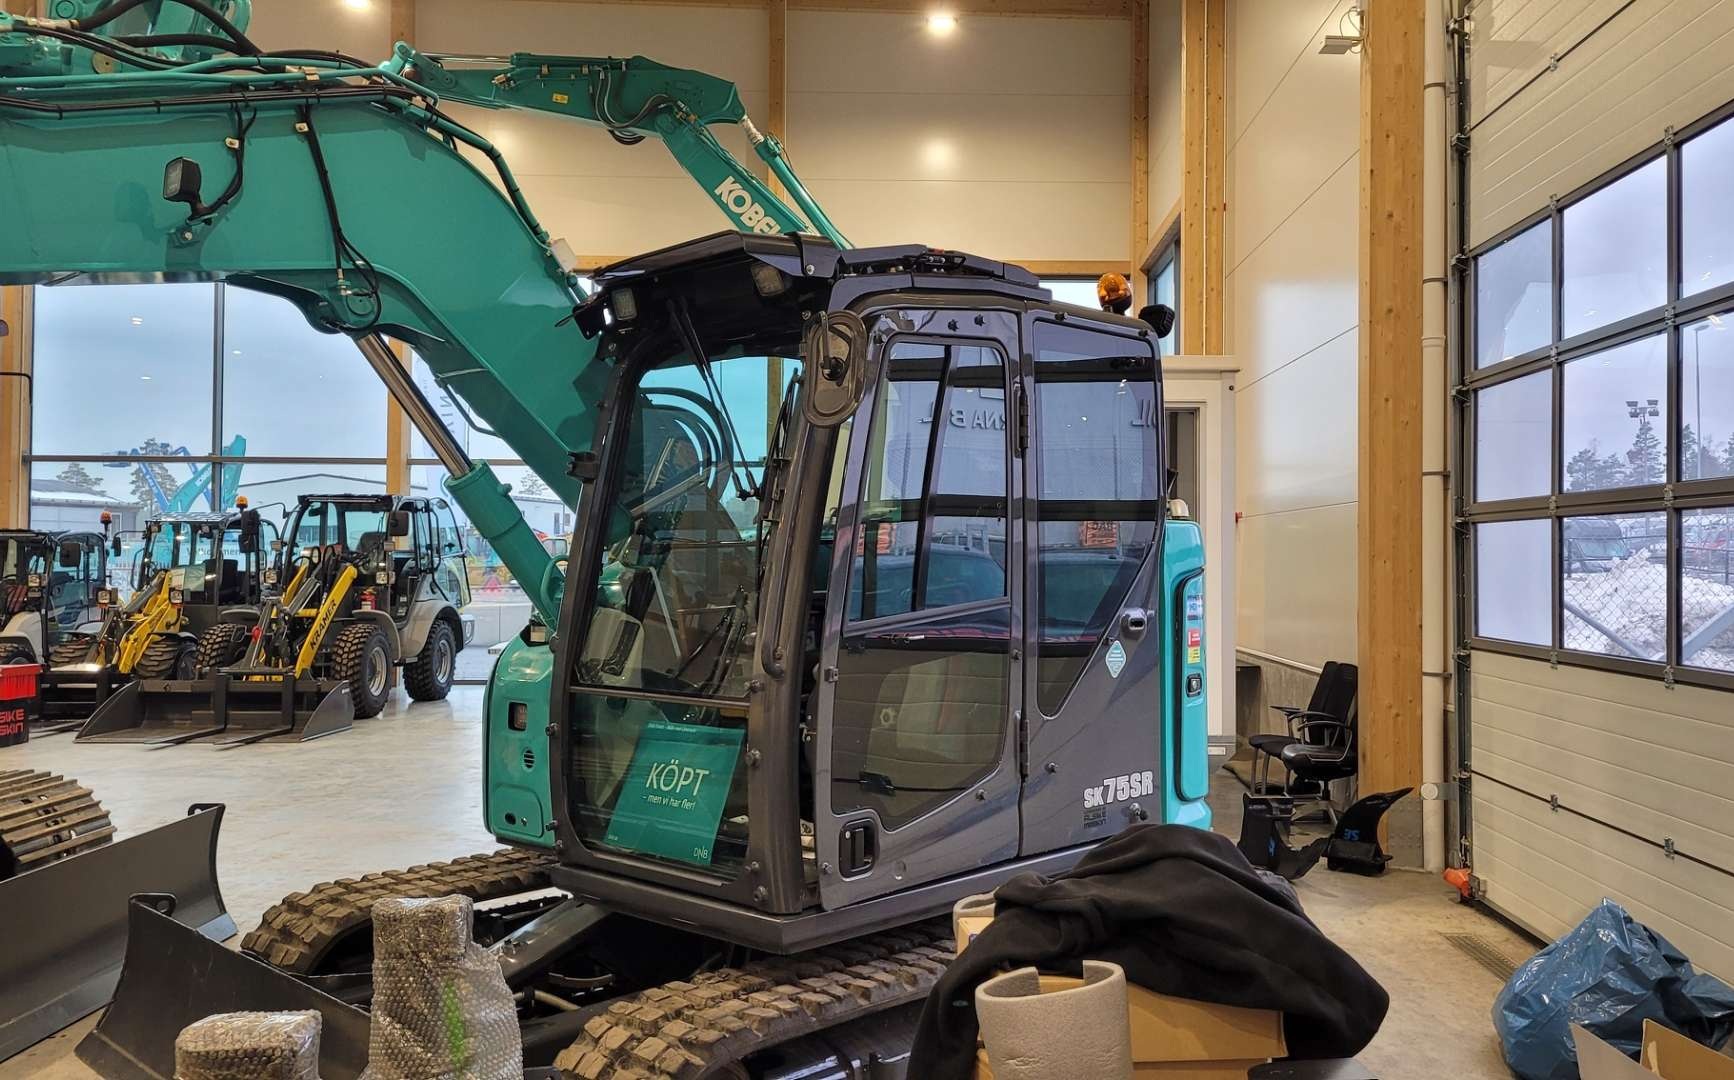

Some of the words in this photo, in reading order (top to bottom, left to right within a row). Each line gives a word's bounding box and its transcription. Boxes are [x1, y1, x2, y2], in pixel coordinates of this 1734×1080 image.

[310, 599, 337, 650] KRAMER
[646, 759, 710, 796] KÖPT
[1083, 770, 1154, 808] SK75SR
[647, 794, 662, 805] men
[693, 846, 708, 859] DNB
